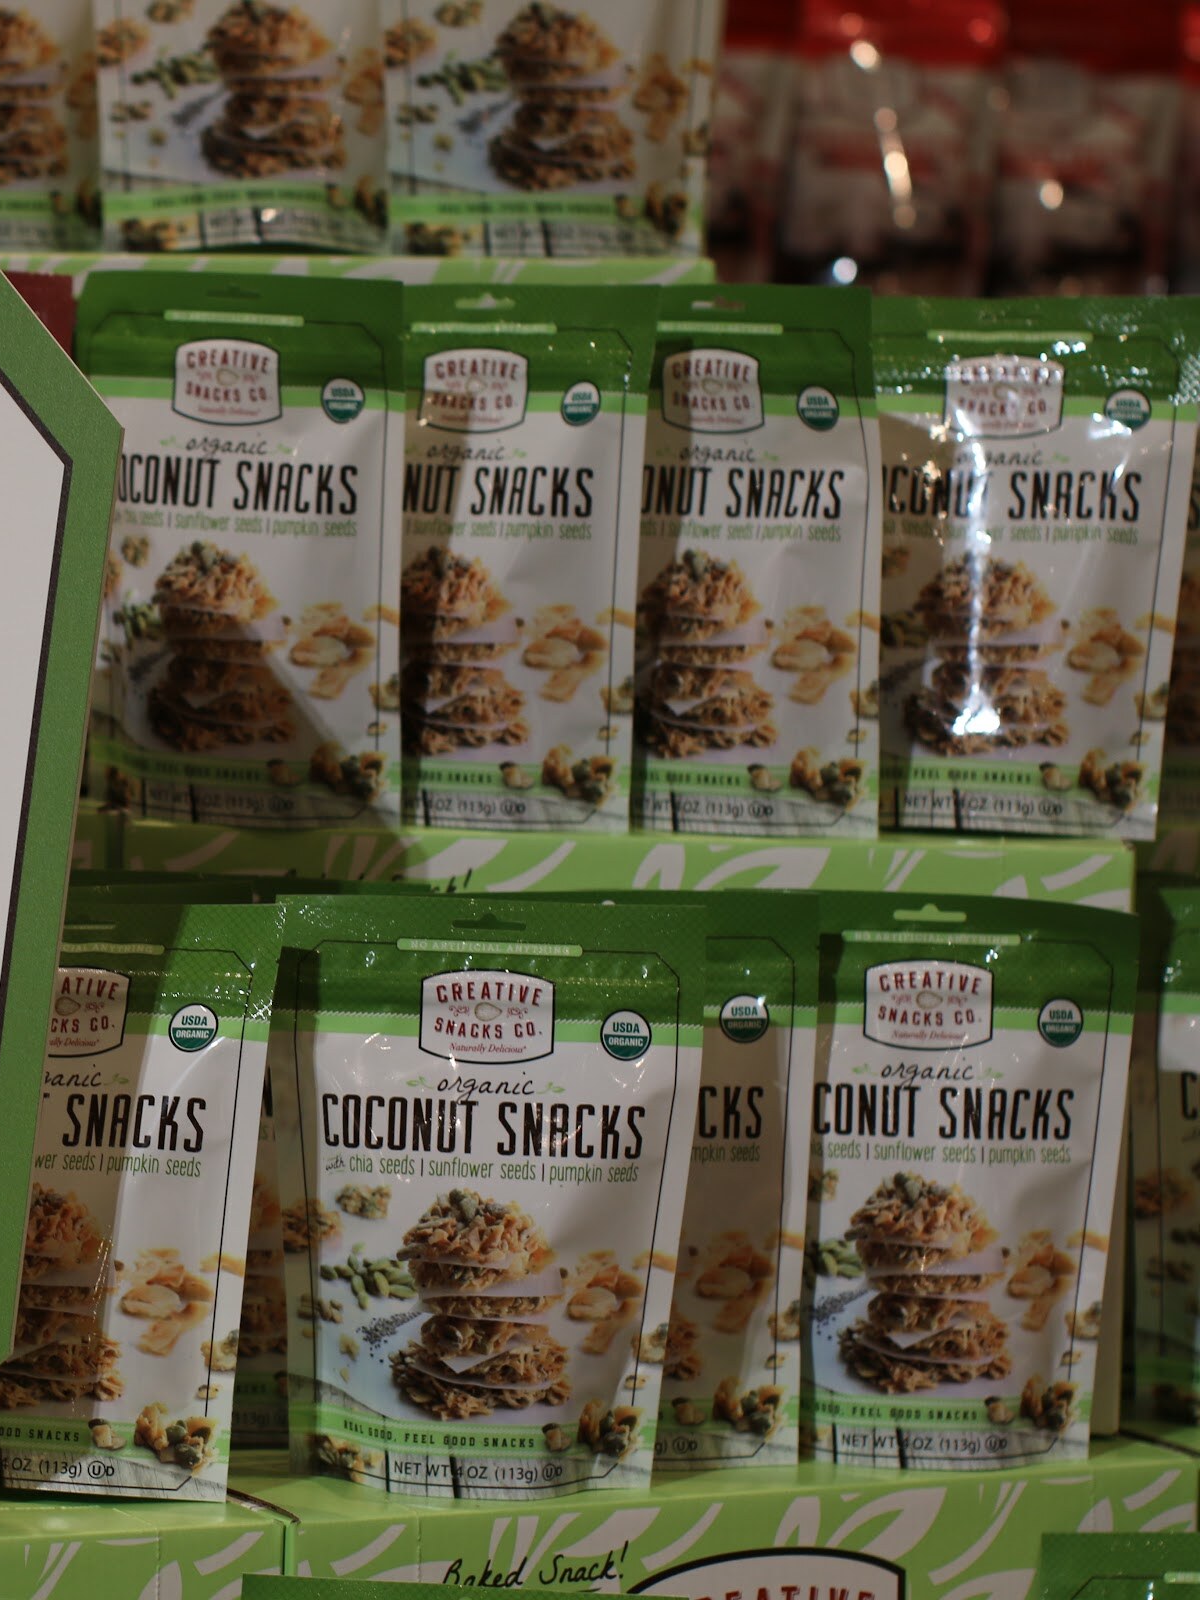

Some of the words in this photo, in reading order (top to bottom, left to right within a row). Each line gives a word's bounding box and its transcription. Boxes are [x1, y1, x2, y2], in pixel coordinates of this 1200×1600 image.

[186, 350, 269, 373] CREATIVE
[434, 358, 519, 381] CREATIVE
[672, 359, 750, 382] CREATIVE
[185, 382, 240, 402] SNACKS
[186, 432, 267, 458] organic
[427, 438, 504, 466] organic
[680, 438, 755, 466] organic
[233, 460, 358, 515] SNACKS
[471, 466, 594, 518] SNACKS
[726, 468, 845, 520] SNACKS
[1008, 470, 1142, 522] SNACKS
[410, 941, 428, 949] NO
[432, 941, 501, 952] ARTIFICIAL
[506, 944, 570, 955] ANYTHING
[61, 976, 119, 1000] ATIVE
[436, 982, 543, 1007] CREATIVE
[879, 971, 982, 996] CREATIVE
[182, 1015, 207, 1026] USDA
[731, 1006, 758, 1017] USDA
[878, 1005, 943, 1026] SNACKS
[1050, 1010, 1074, 1020] USDA
[176, 1029, 209, 1039] ORGANIC
[435, 1017, 503, 1038] SNACKS
[514, 1022, 543, 1038] CO.
[613, 1022, 640, 1033] USDA
[727, 1020, 762, 1029] ORGANIC
[1045, 1024, 1076, 1033] ORGANIC
[450, 1043, 487, 1053] Naturally
[608, 1036, 643, 1046] ORGANIC
[881, 1057, 974, 1087] organic
[437, 1071, 535, 1103] organic
[62, 1093, 207, 1153] SNACKS
[698, 1085, 764, 1139] CKS
[814, 1082, 921, 1137] CONUT
[939, 1086, 1075, 1141] SNACKS
[322, 1093, 478, 1154] COCONUT
[497, 1102, 646, 1160] SNACKS
[63, 1151, 96, 1171] seeds
[107, 1153, 160, 1176] pumpkin
[165, 1156, 202, 1178] seeds
[828, 1140, 861, 1159] seeds
[874, 1140, 936, 1162] sunflower
[942, 1145, 976, 1163] seeds
[988, 1146, 1036, 1167] pumpkin
[1041, 1146, 1071, 1164] seeds
[350, 1155, 373, 1172] chia
[379, 1157, 415, 1175] seeds
[428, 1157, 493, 1178] sunflower
[500, 1161, 536, 1181] seeds
[550, 1162, 602, 1184] pumpkin
[607, 1163, 638, 1183] seeds
[852, 1406, 881, 1418] FEEL
[889, 1408, 921, 1419] GOOD
[928, 1410, 978, 1421] SNACKS
[29, 1429, 80, 1442] SNACKS
[405, 1433, 435, 1445] FEEL
[443, 1435, 476, 1447] GOOD
[484, 1437, 535, 1448] SNACKS
[841, 1434, 868, 1448] NET
[873, 1435, 897, 1449] WT
[912, 1435, 933, 1450] OZ
[939, 1437, 981, 1453] (113g)
[12, 1458, 32, 1472] OZ
[38, 1462, 82, 1479] (113g)
[394, 1461, 421, 1475] NET
[425, 1463, 449, 1477] WT
[467, 1466, 488, 1479] OZ
[495, 1466, 538, 1484] (113g)
[538, 1541, 628, 1586] Snack!
